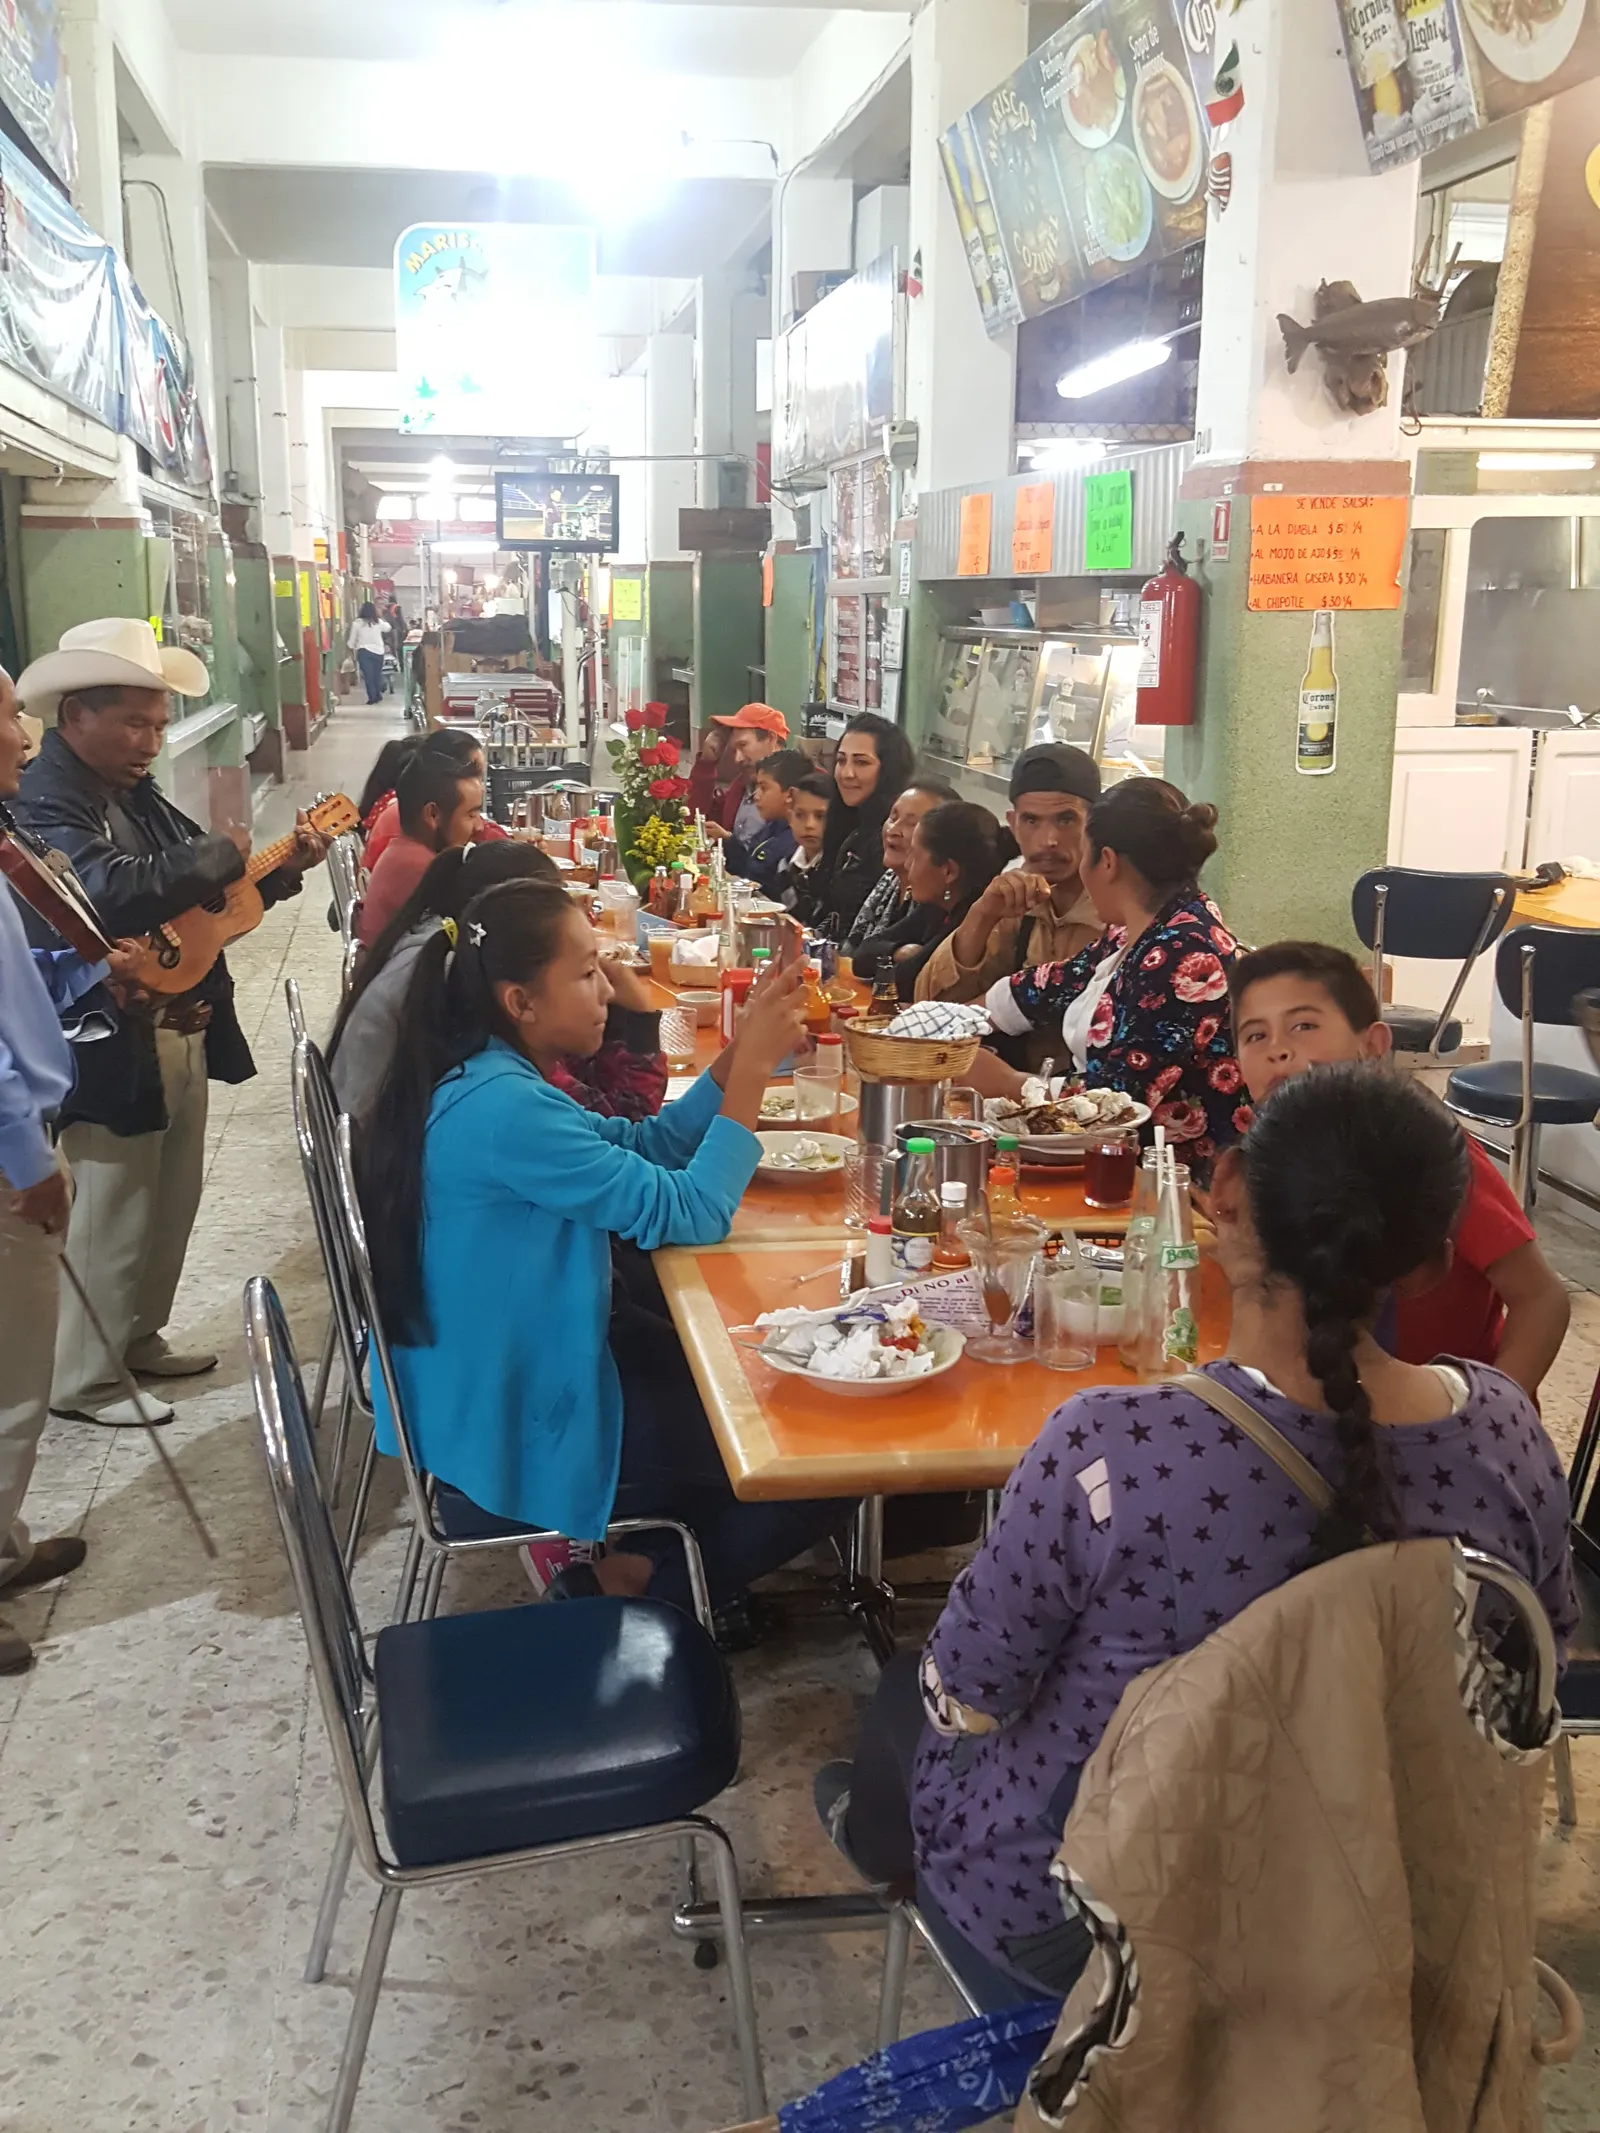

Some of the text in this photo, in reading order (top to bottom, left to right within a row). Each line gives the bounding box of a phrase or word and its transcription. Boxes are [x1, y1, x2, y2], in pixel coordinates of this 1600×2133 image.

[1363, 24, 1388, 50] Extra
[1408, 18, 1439, 53] Light
[1013, 214, 1059, 275] COZUMEL
[1296, 497, 1306, 509] SE
[1310, 496, 1337, 509] VENDE
[1255, 524, 1264, 535] A
[1268, 523, 1281, 535] LA
[1287, 523, 1318, 536] DIABLA
[1254, 548, 1264, 559] AL
[1269, 548, 1295, 560] MOJO
[1298, 548, 1308, 559] DE
[1310, 548, 1325, 559] AJO
[1252, 572, 1299, 585] HABANERA
[1304, 572, 1335, 584] CASERA
[1252, 597, 1262, 609] AL
[1266, 596, 1305, 609] CHIPOTLE
[924, 1279, 950, 1292] NO
